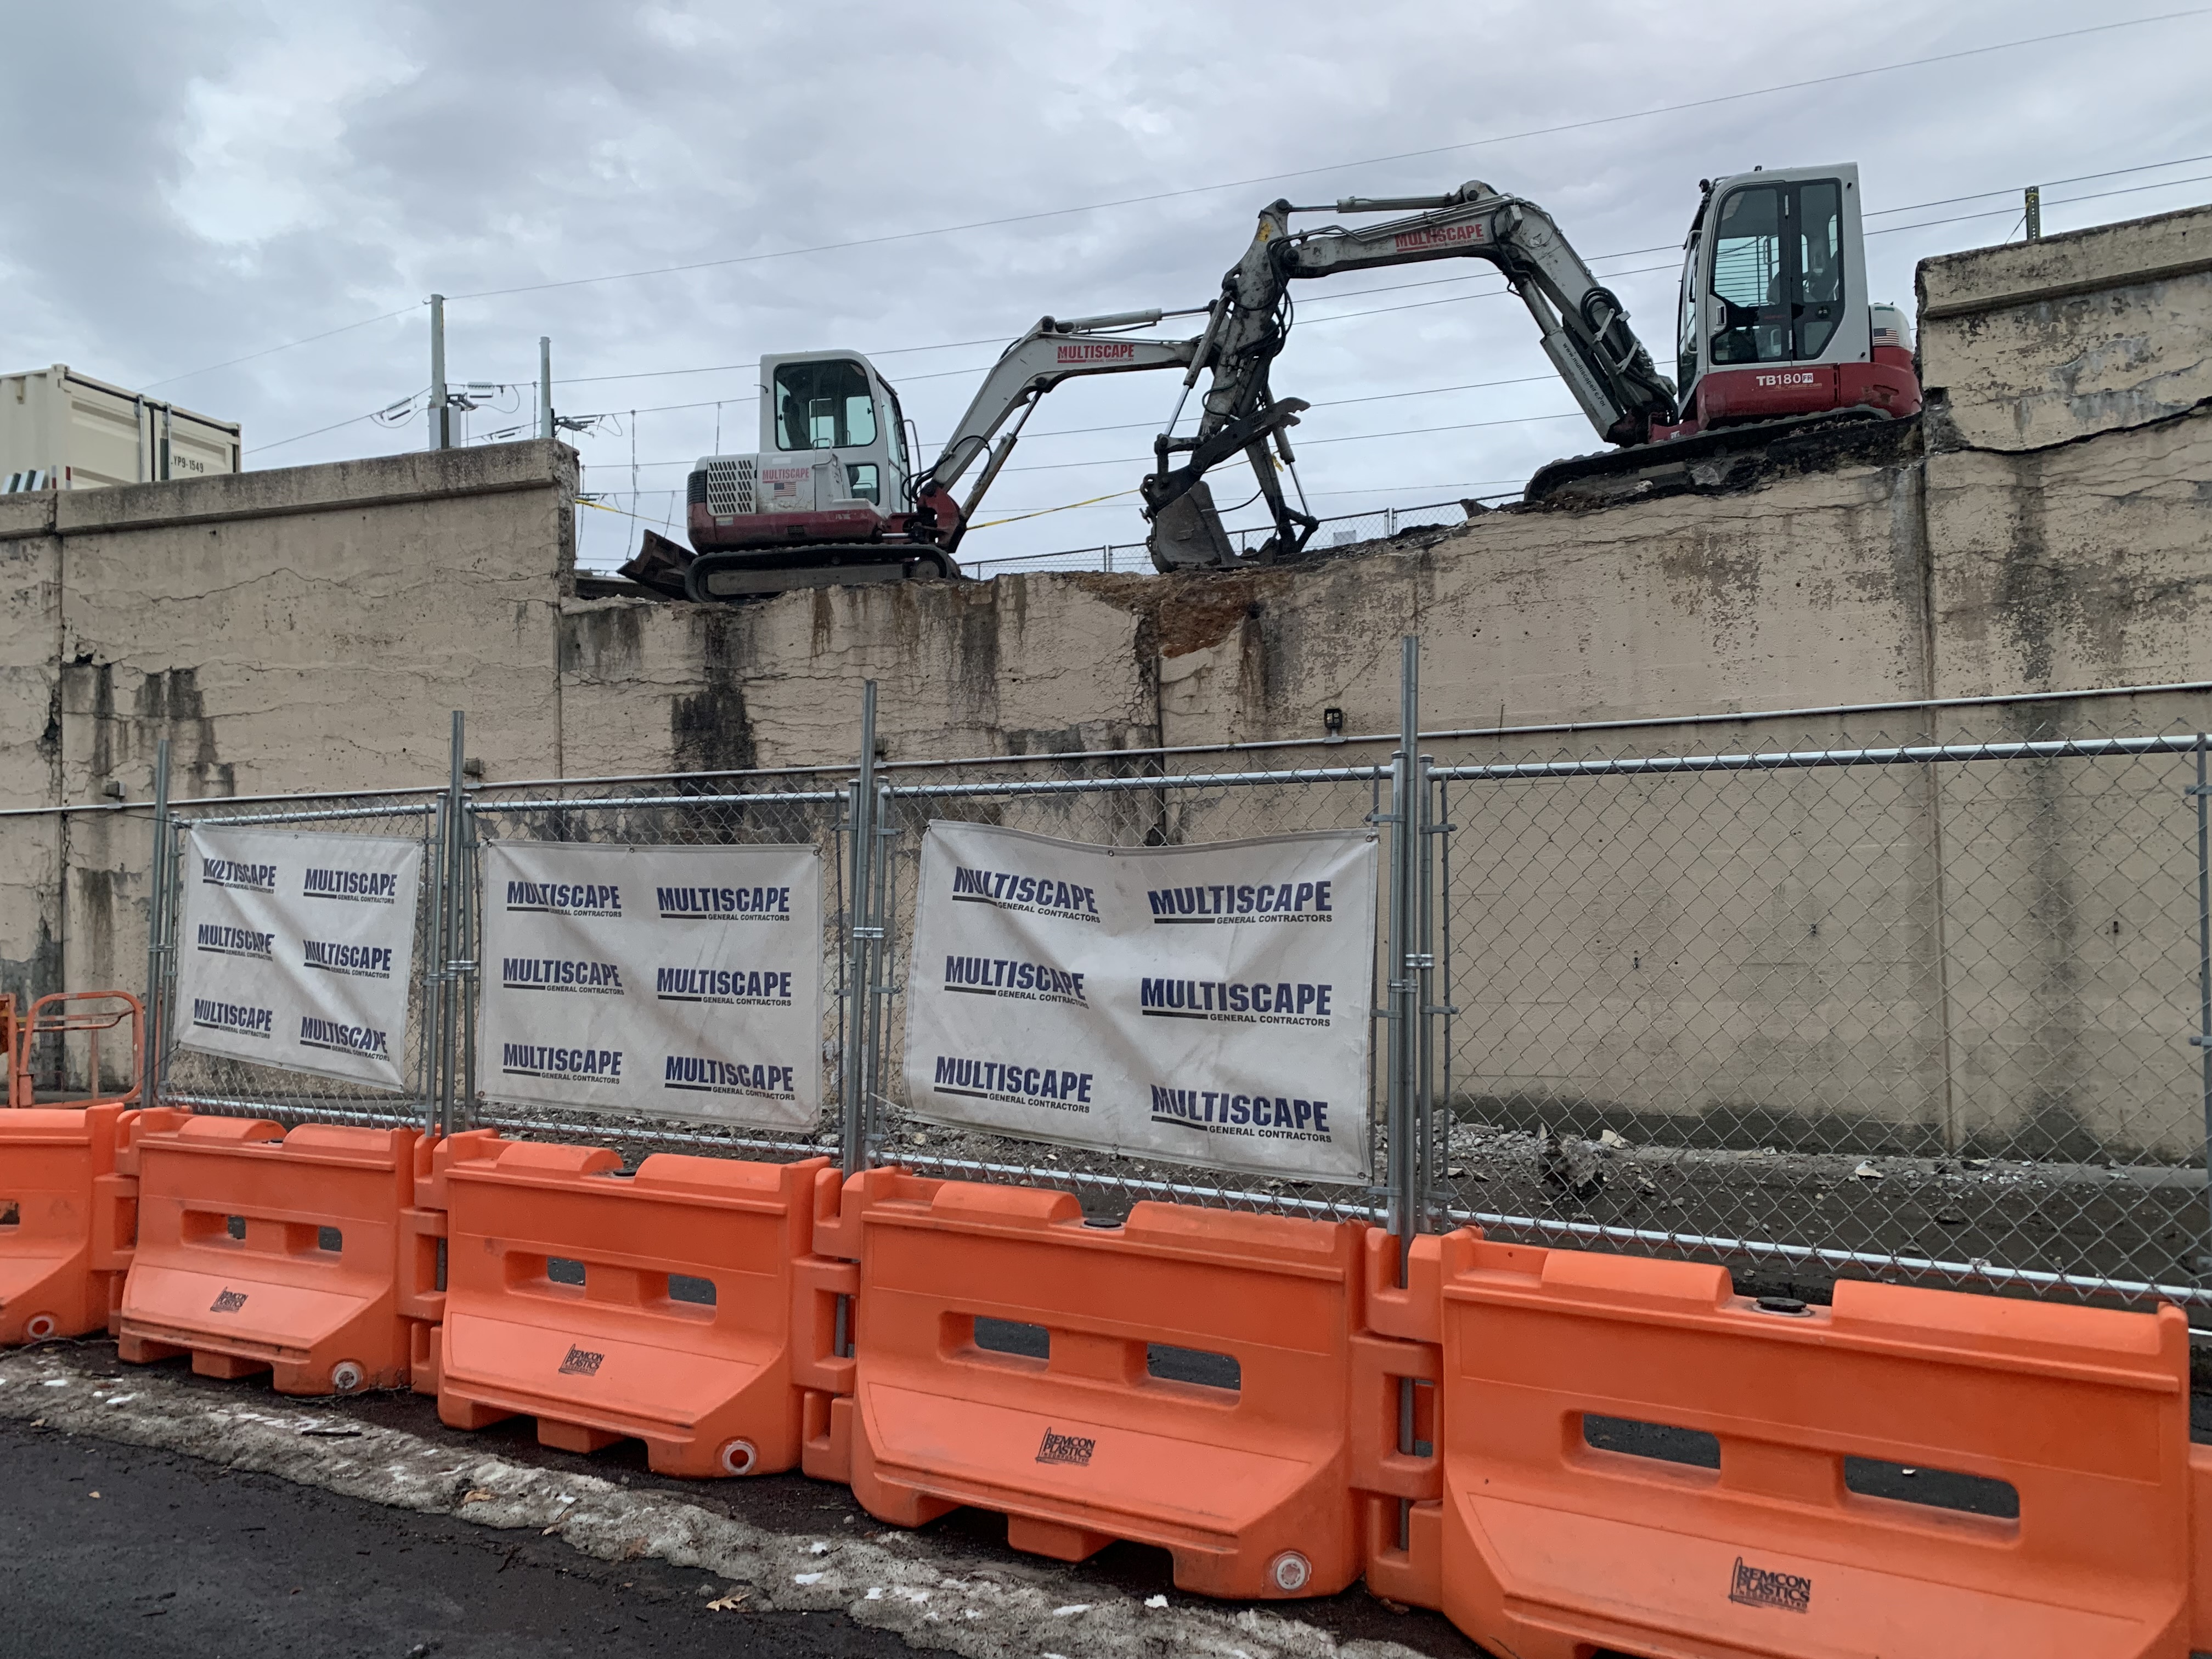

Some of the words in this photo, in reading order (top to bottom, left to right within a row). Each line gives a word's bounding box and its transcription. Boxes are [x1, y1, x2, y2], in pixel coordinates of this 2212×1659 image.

[1395, 224, 1484, 247] MULTISCAPE
[1057, 344, 1135, 359] MULTISCAPE
[171, 455, 204, 473] YP9-1549
[762, 467, 810, 481] MULTISCAPE
[304, 868, 398, 896] MULTISCAPE
[953, 866, 1098, 913] MULTISCAPE
[360, 896, 394, 904] CONTRACTORS
[507, 881, 622, 909] MULTISCAPE
[657, 887, 789, 912] MULTISCAPE
[1148, 881, 1332, 914] MULTISCAPE
[997, 901, 1035, 913] GENERAL
[1038, 908, 1101, 923] CONTRACTORS
[1216, 916, 1256, 924] GENERAL
[1259, 915, 1333, 923] CONTRACTORS
[198, 924, 275, 955] MULTISCAPE
[303, 939, 392, 971] MULTISCAPE
[352, 969, 390, 979] CONTRACTORS
[503, 958, 622, 987] MULTISCAPE
[657, 968, 791, 997] MULTISCAPE
[945, 956, 1086, 1000] MULTISCAPE
[579, 987, 624, 995] CONTRACTORS
[736, 998, 792, 1006] CONTRACTORS
[997, 989, 1036, 1001] GENERAL
[1141, 978, 1331, 1015] MULTISCAPE
[194, 998, 273, 1031] MULTISCAPE
[1210, 1013, 1257, 1023] GENERAL
[1260, 1015, 1330, 1027] CONTRACTORS
[301, 1017, 388, 1054] MULTISCAPE
[504, 1043, 622, 1076] MULTISCAPE
[541, 1072, 571, 1080] GENERAL
[573, 1075, 620, 1085] CONTRACTORS
[665, 1056, 794, 1092] MULTISCAPE
[935, 1056, 1093, 1102] MULTISCAPE
[713, 1086, 744, 1094] GENERAL
[746, 1090, 795, 1101] CONTRACTORS
[989, 1093, 1026, 1105] GENERAL
[1028, 1098, 1090, 1114] CONTRACTORS
[1150, 1084, 1330, 1132] MULTISCAPE
[1209, 1126, 1255, 1137] GENERAL
[1259, 1129, 1332, 1143] CONTRACTORS
[565, 1356, 600, 1369] PLASTICS
[569, 1349, 605, 1362] REMCON
[1043, 1443, 1092, 1458] PLASTICS
[1046, 1434, 1096, 1449] REMCON
[1736, 1577, 1810, 1602] PLASTICS
[1738, 1565, 1812, 1591] REMCON
